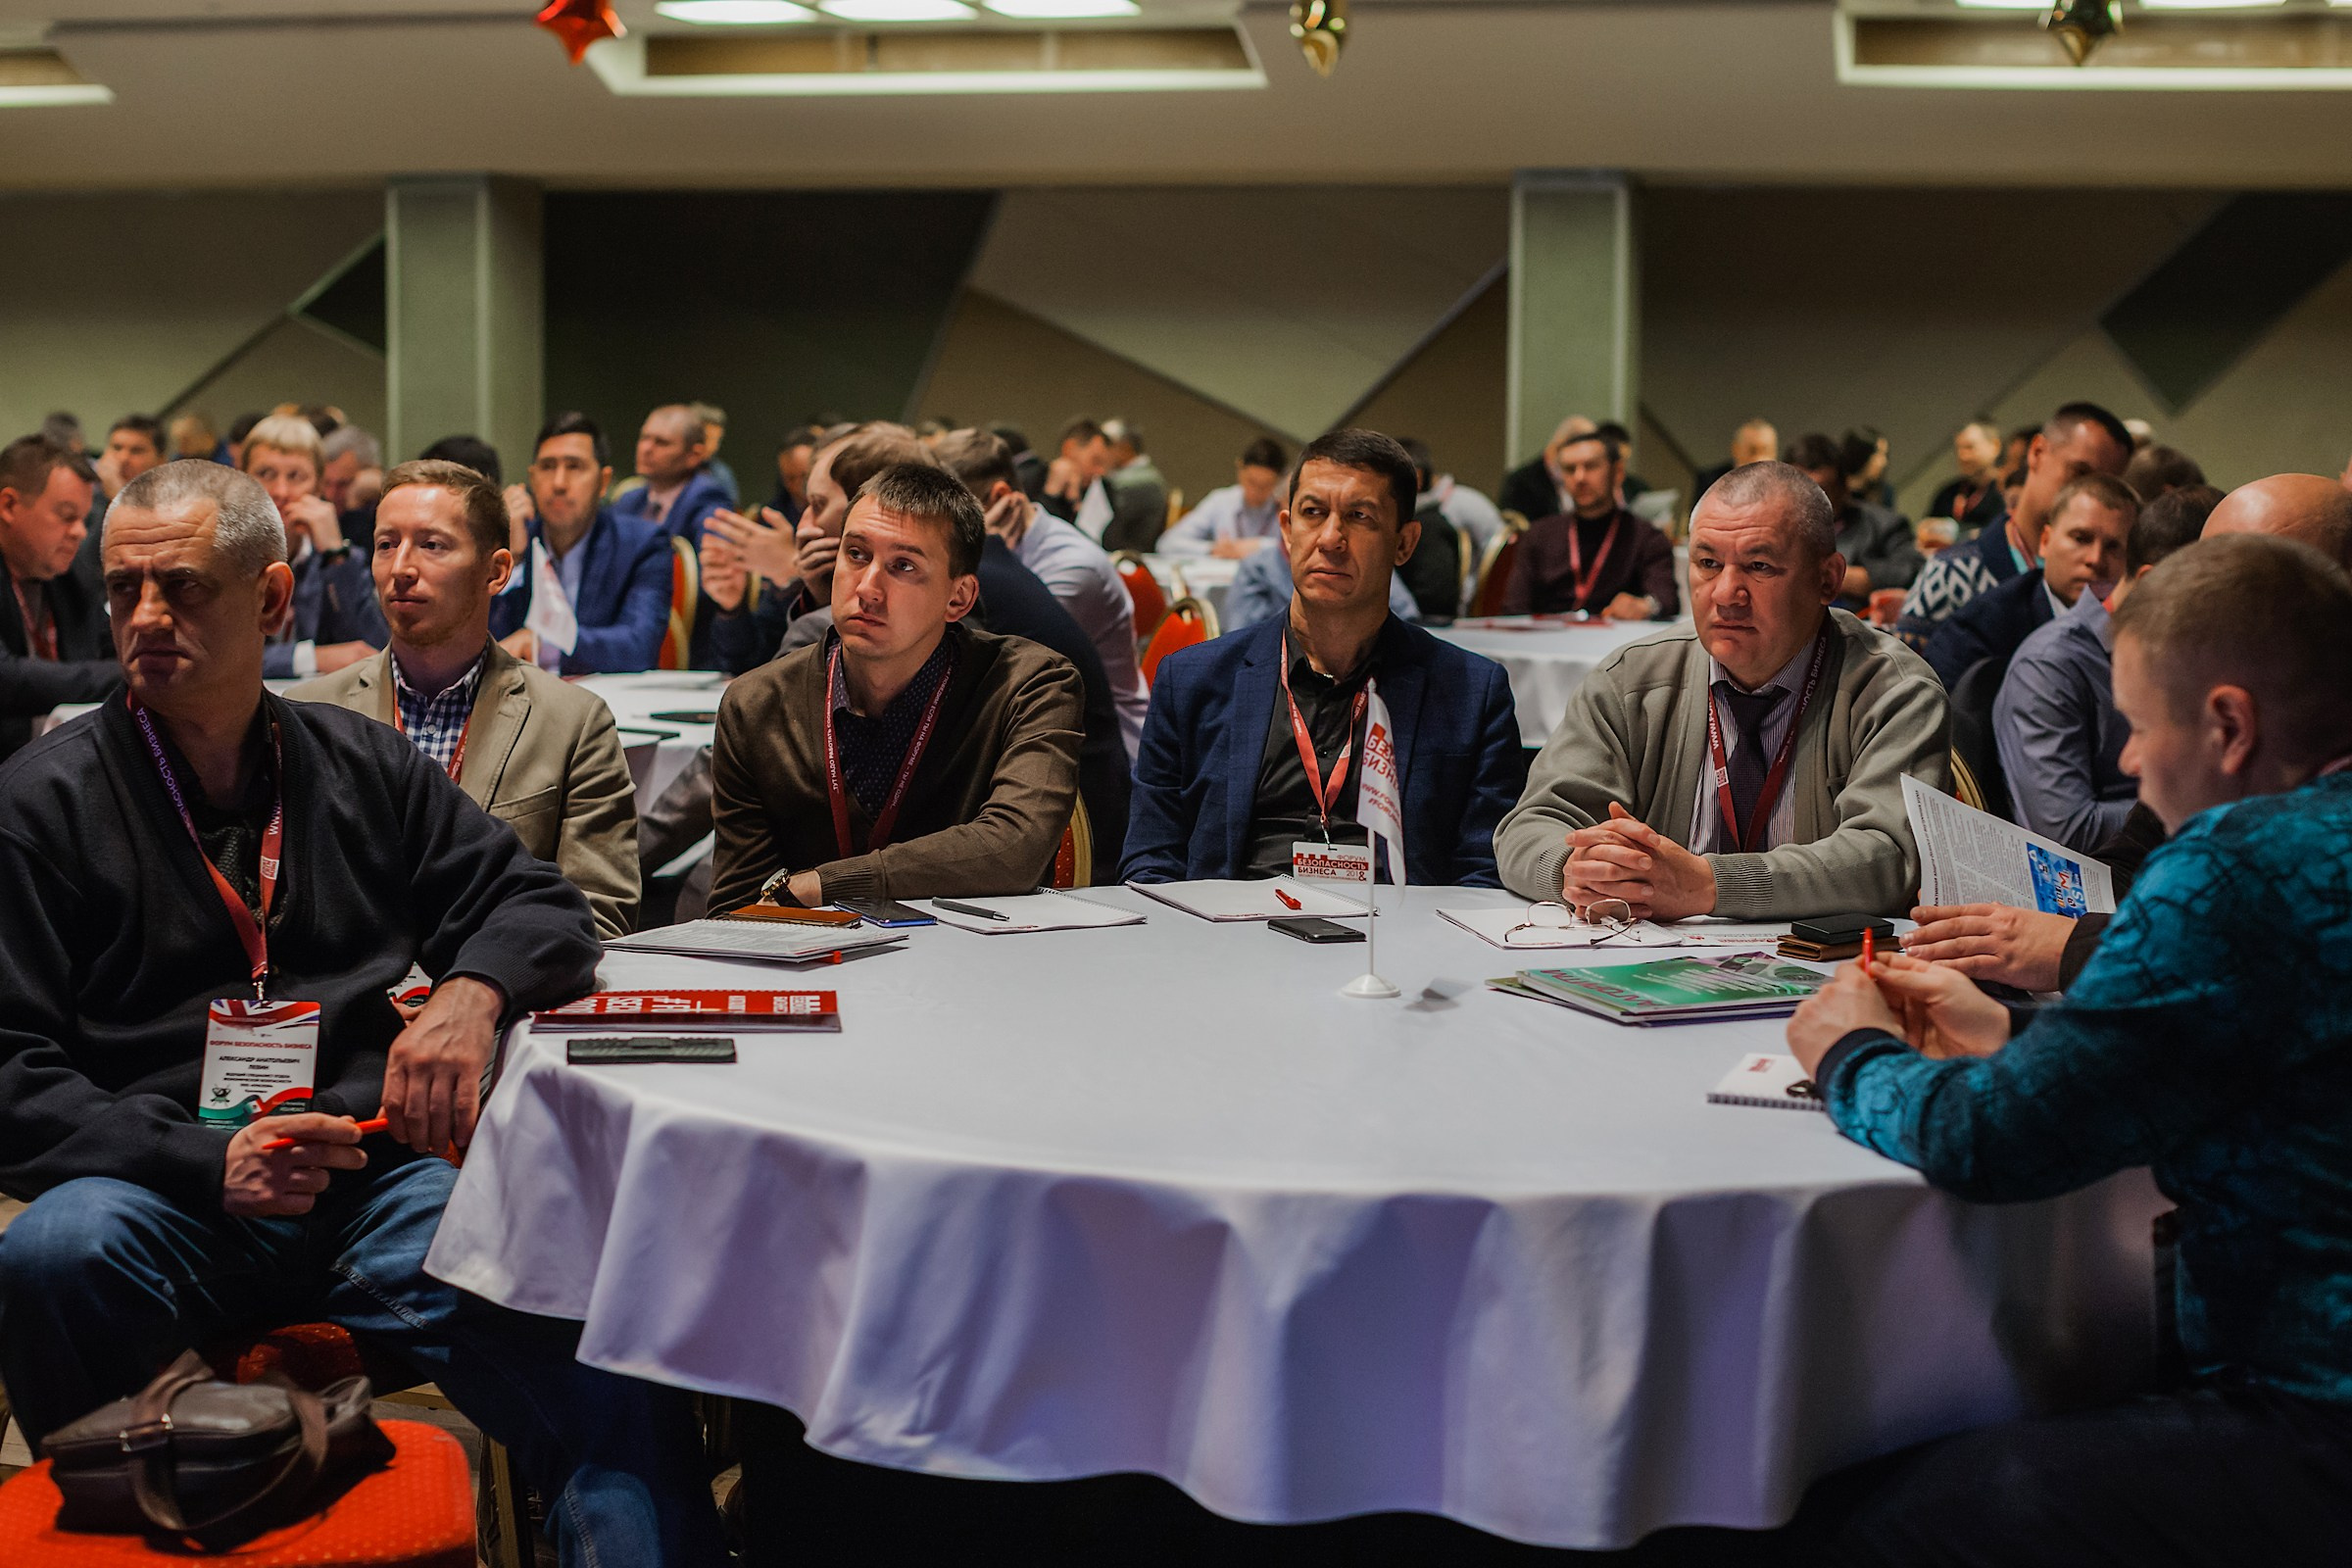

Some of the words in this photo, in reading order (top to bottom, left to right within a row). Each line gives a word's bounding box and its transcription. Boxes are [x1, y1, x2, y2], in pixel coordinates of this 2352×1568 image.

[136, 707, 163, 758] БИЗНЕСА
[1298, 858, 1366, 870] БЕЗОПАСНОСТЬ
[1298, 866, 1337, 875] БИЗНЕСА
